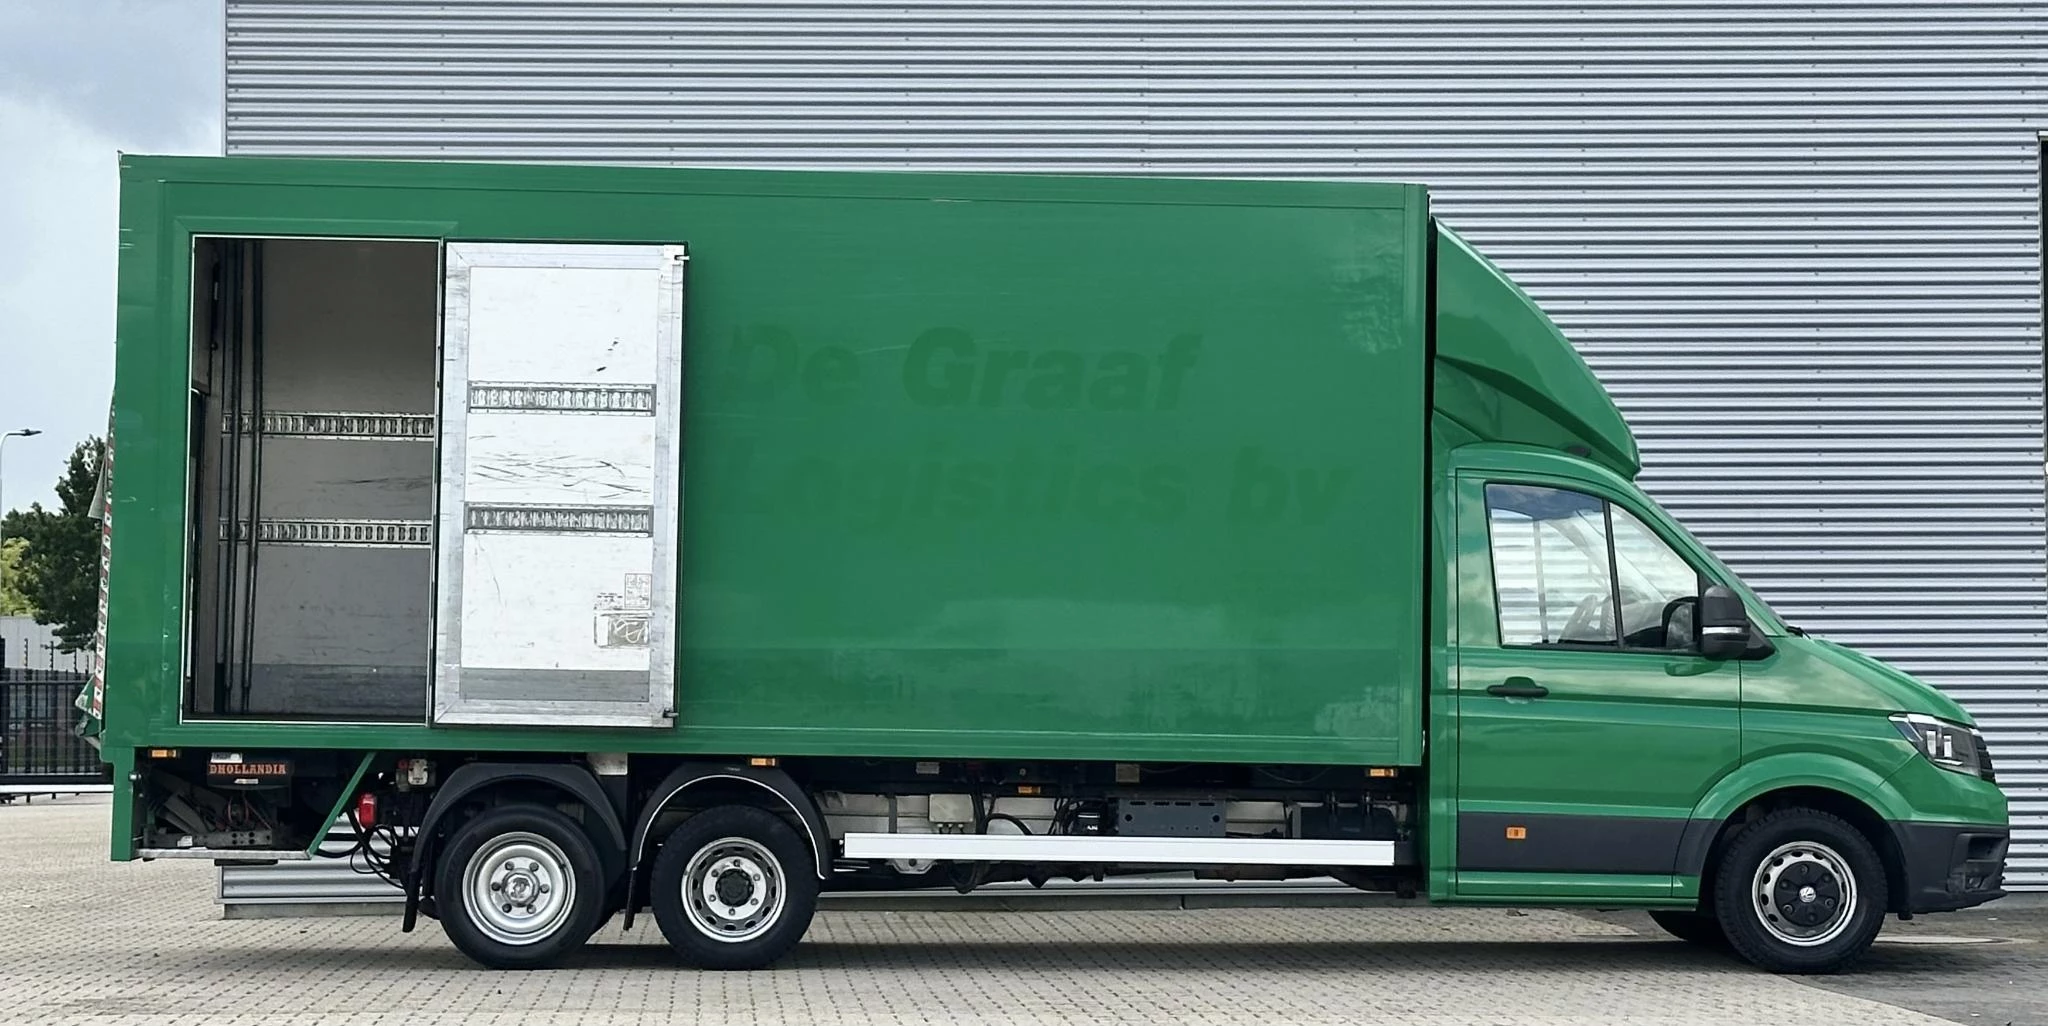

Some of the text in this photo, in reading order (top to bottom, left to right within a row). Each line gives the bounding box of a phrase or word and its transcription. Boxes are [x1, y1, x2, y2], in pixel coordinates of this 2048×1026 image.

[724, 324, 1204, 411] De Graaf
[722, 435, 1188, 533] Logistics
[209, 763, 286, 775] DHOLLANDIA
